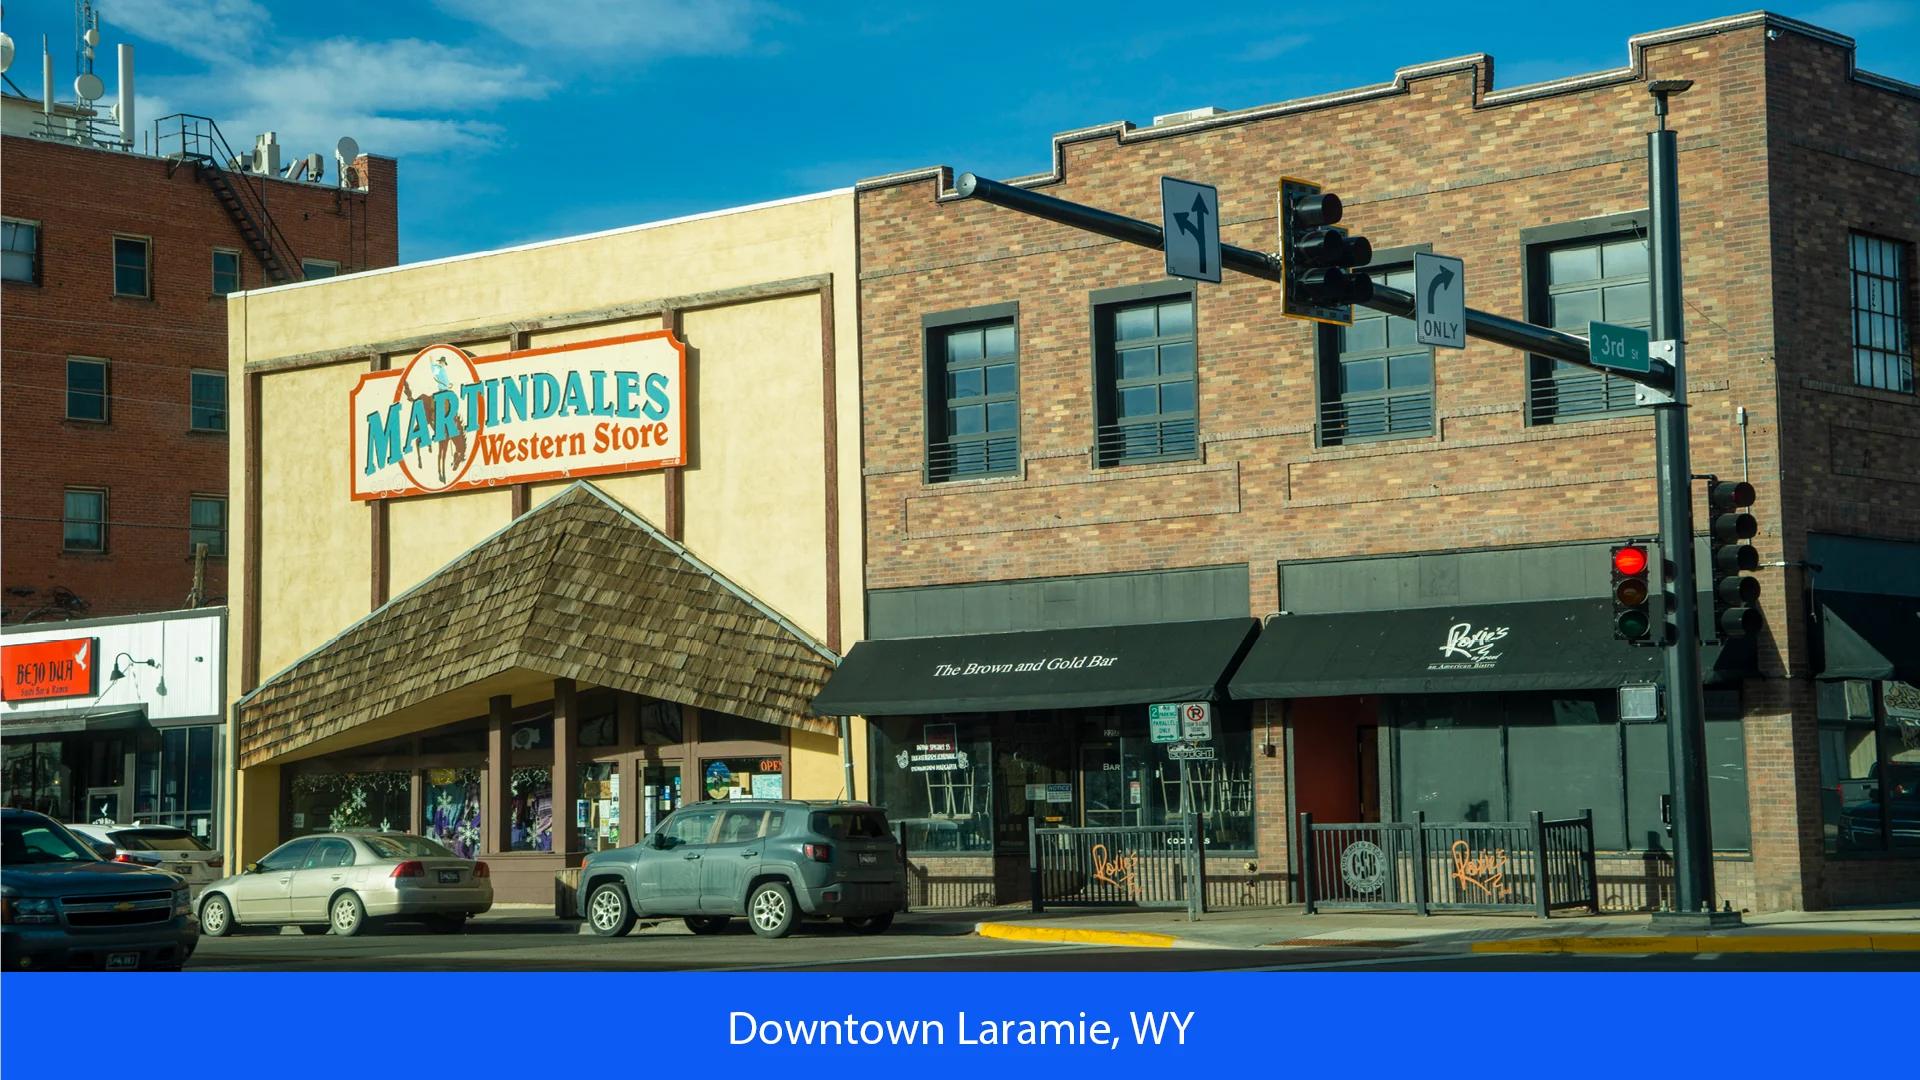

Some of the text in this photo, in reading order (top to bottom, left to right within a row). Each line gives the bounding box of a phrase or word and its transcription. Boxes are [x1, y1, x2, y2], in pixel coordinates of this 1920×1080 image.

[1423, 319, 1458, 340] ONLY
[1601, 334, 1625, 358] 3rd
[364, 370, 670, 475] MARTINDALES
[479, 421, 669, 466] Western Store
[1439, 622, 1510, 657] Roxie's
[16, 662, 45, 686] BEJO
[933, 655, 1118, 677] The Brown and Gold Bar
[1151, 707, 1158, 718] 2
